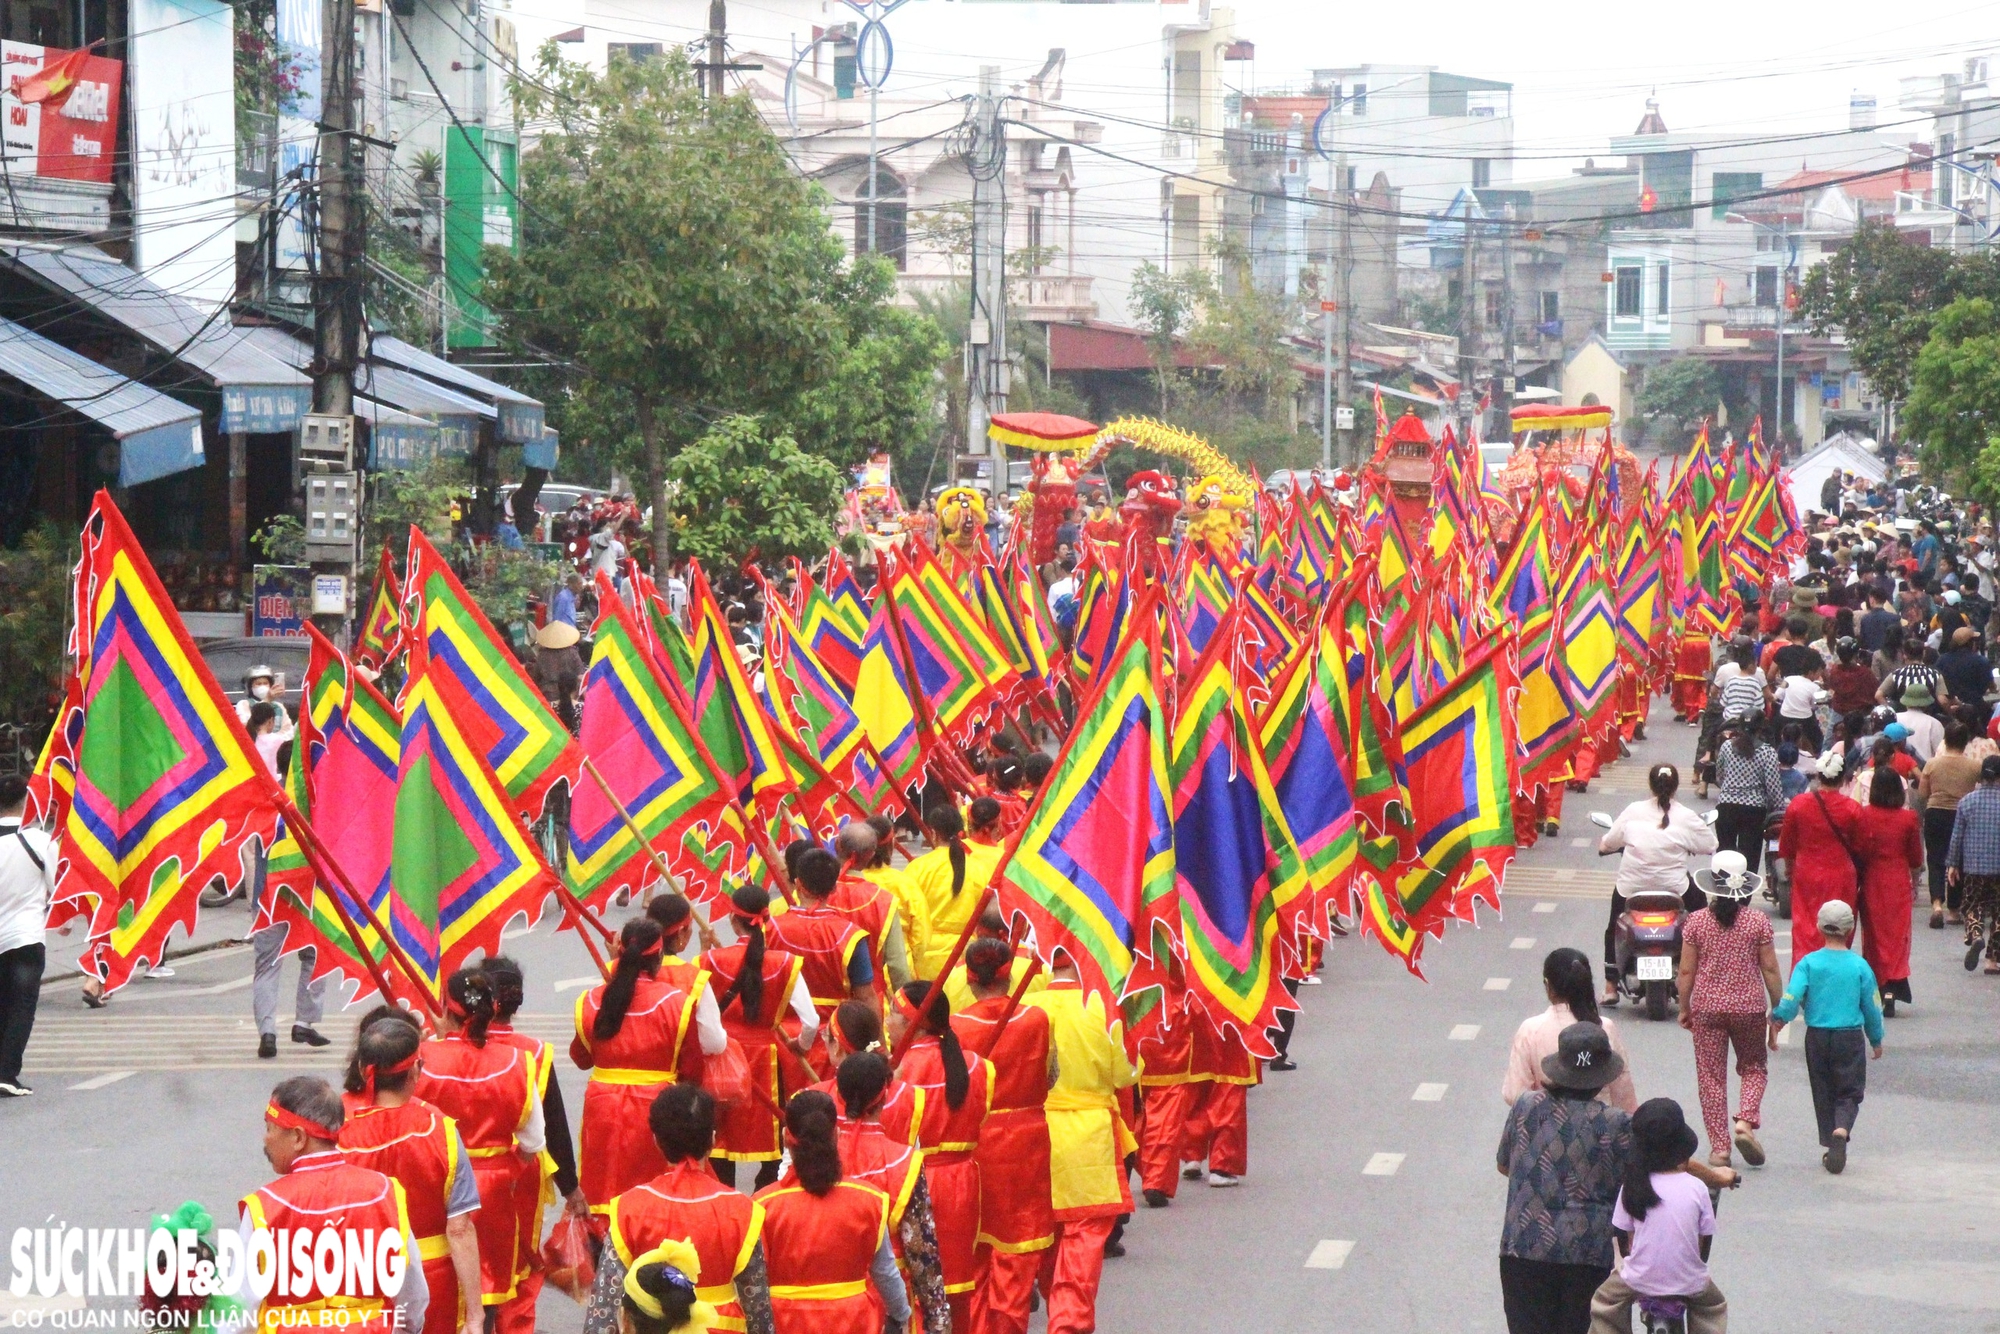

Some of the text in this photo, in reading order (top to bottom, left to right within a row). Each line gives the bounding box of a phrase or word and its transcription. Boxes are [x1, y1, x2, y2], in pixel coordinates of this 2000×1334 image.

[259, 592, 294, 623] ĐIỆN
[1644, 958, 1667, 968] 15-AA
[1576, 1051, 1592, 1067] NY
